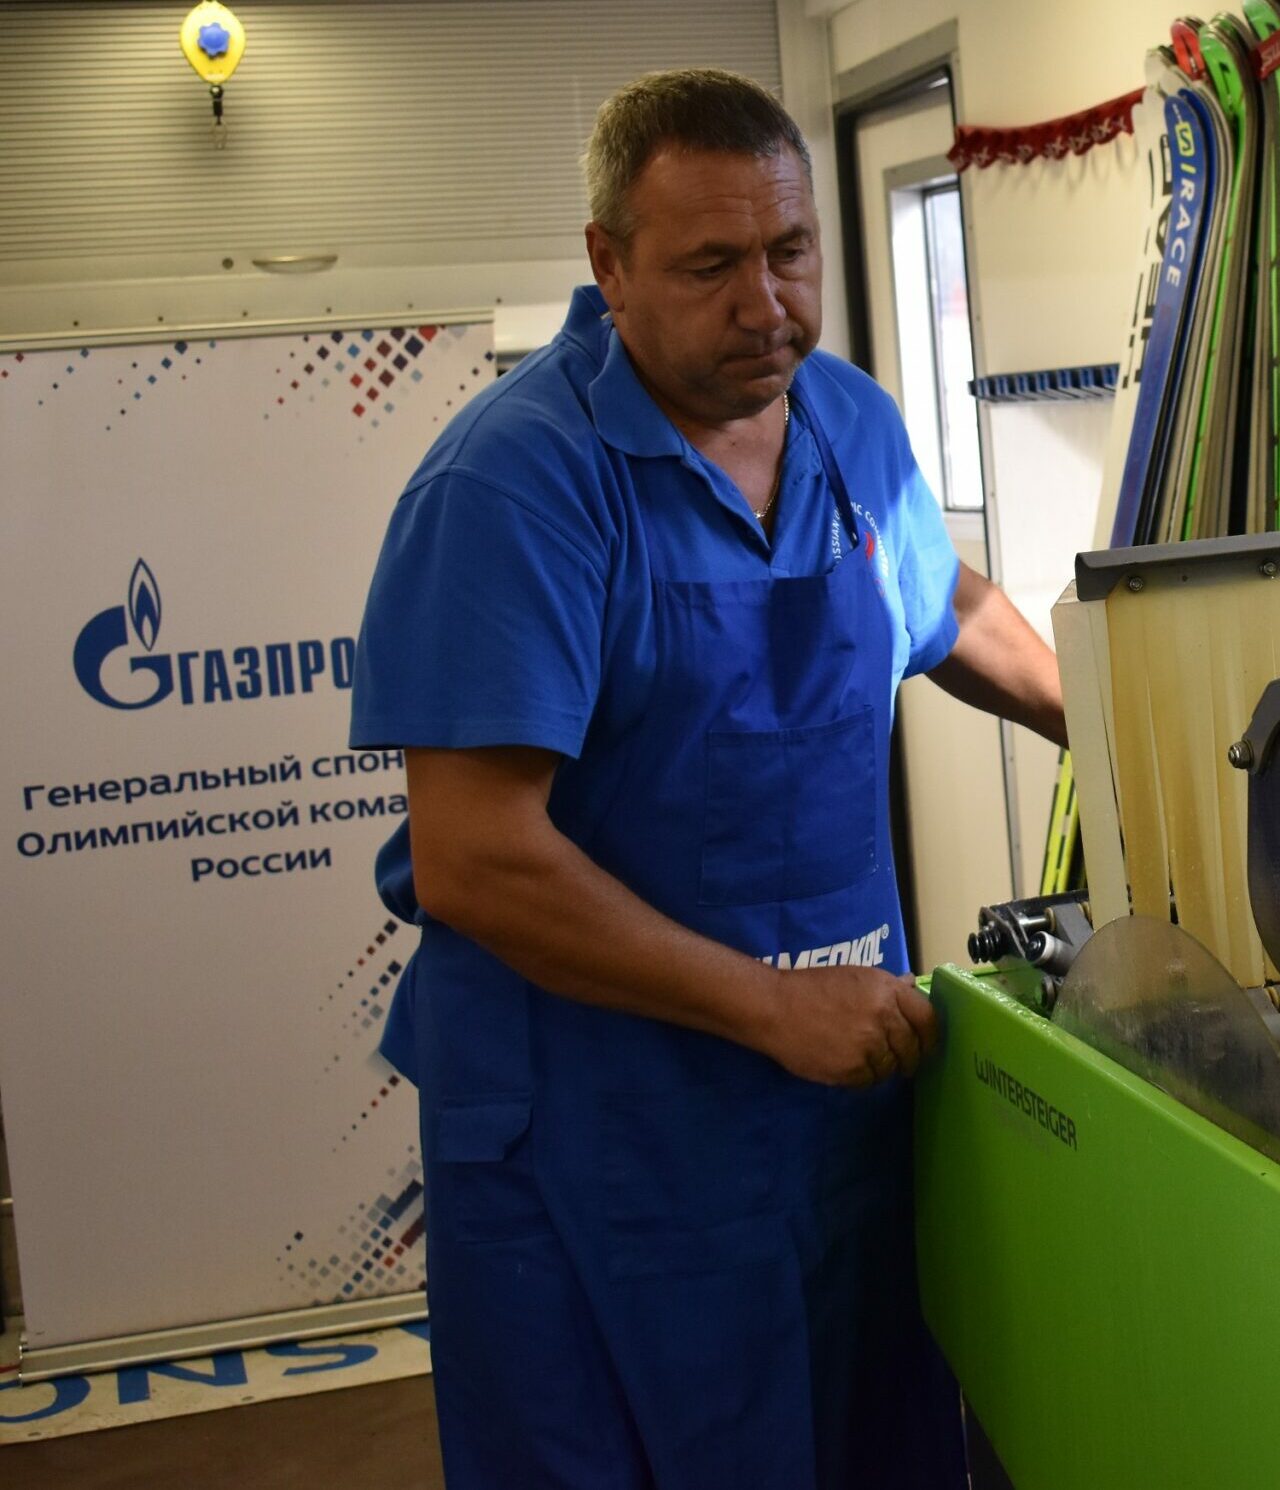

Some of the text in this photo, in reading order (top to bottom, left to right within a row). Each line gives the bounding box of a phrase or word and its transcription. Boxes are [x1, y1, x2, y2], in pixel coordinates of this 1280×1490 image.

[177, 636, 356, 706] ГАЗПРО
[22, 750, 404, 811] Генеральный спон
[16, 793, 409, 858] Олимпийской кома
[190, 847, 332, 883] России
[974, 1051, 1078, 1153] WINTERSTEIGER
